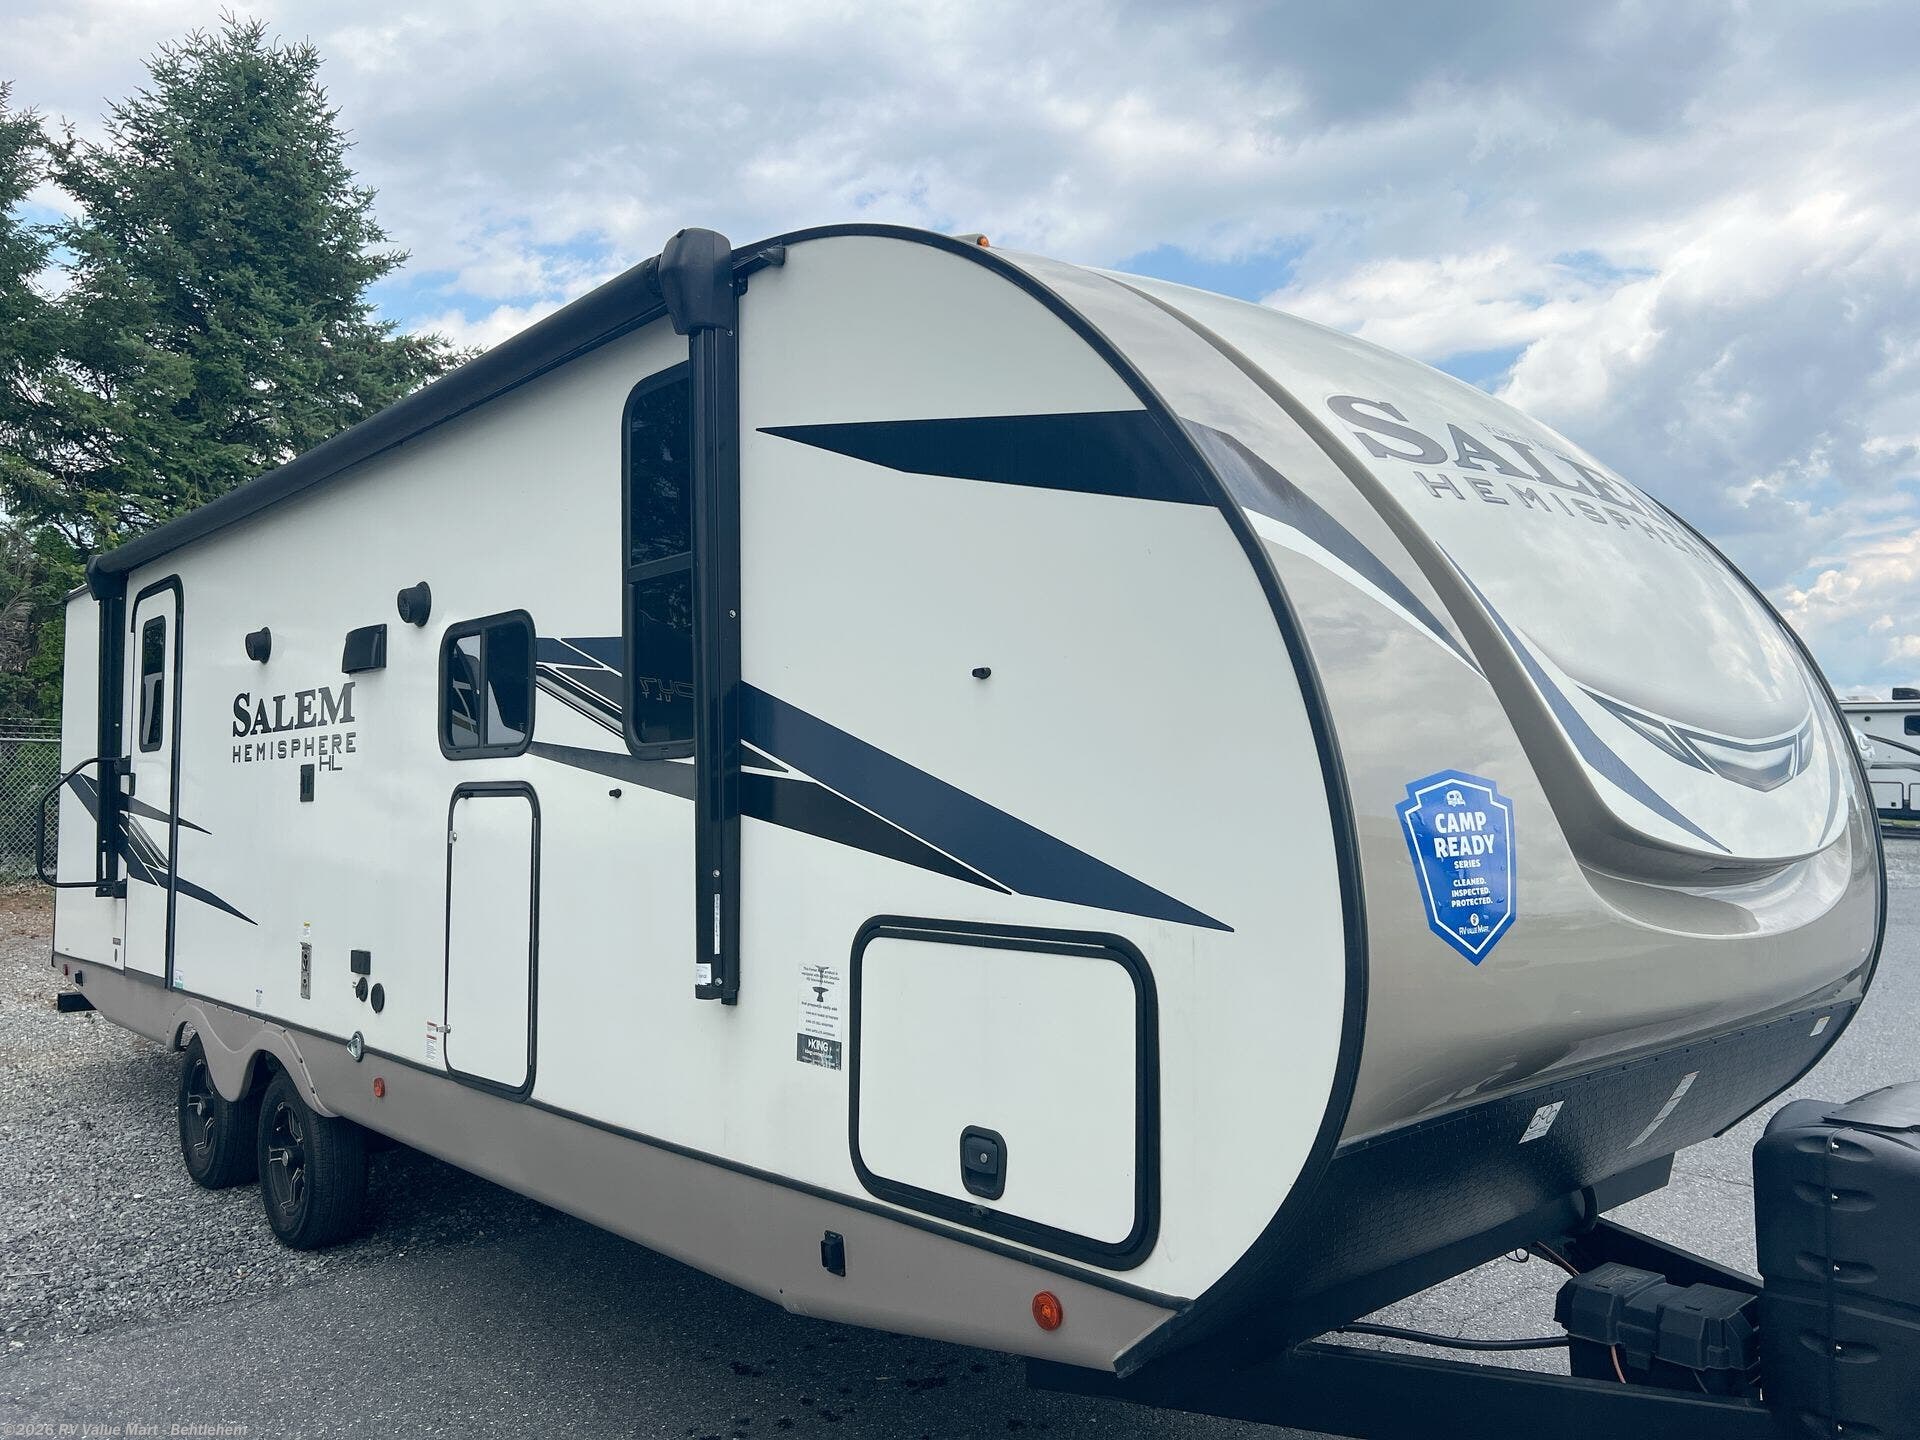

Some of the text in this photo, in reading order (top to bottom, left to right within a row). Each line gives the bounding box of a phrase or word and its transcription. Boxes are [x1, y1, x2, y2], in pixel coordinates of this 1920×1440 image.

[232, 681, 356, 738] SALEM
[232, 731, 357, 764] HEMISPHERE
[319, 754, 343, 772] HL
[1435, 811, 1487, 834] CAMP
[1434, 834, 1495, 858] READY
[1453, 859, 1481, 870] SERIES
[1453, 877, 1486, 887] CLEANED.
[1451, 888, 1491, 898] INSPECTED.
[1450, 897, 1494, 908] PROTECTED.
[811, 1038, 829, 1052] KING
